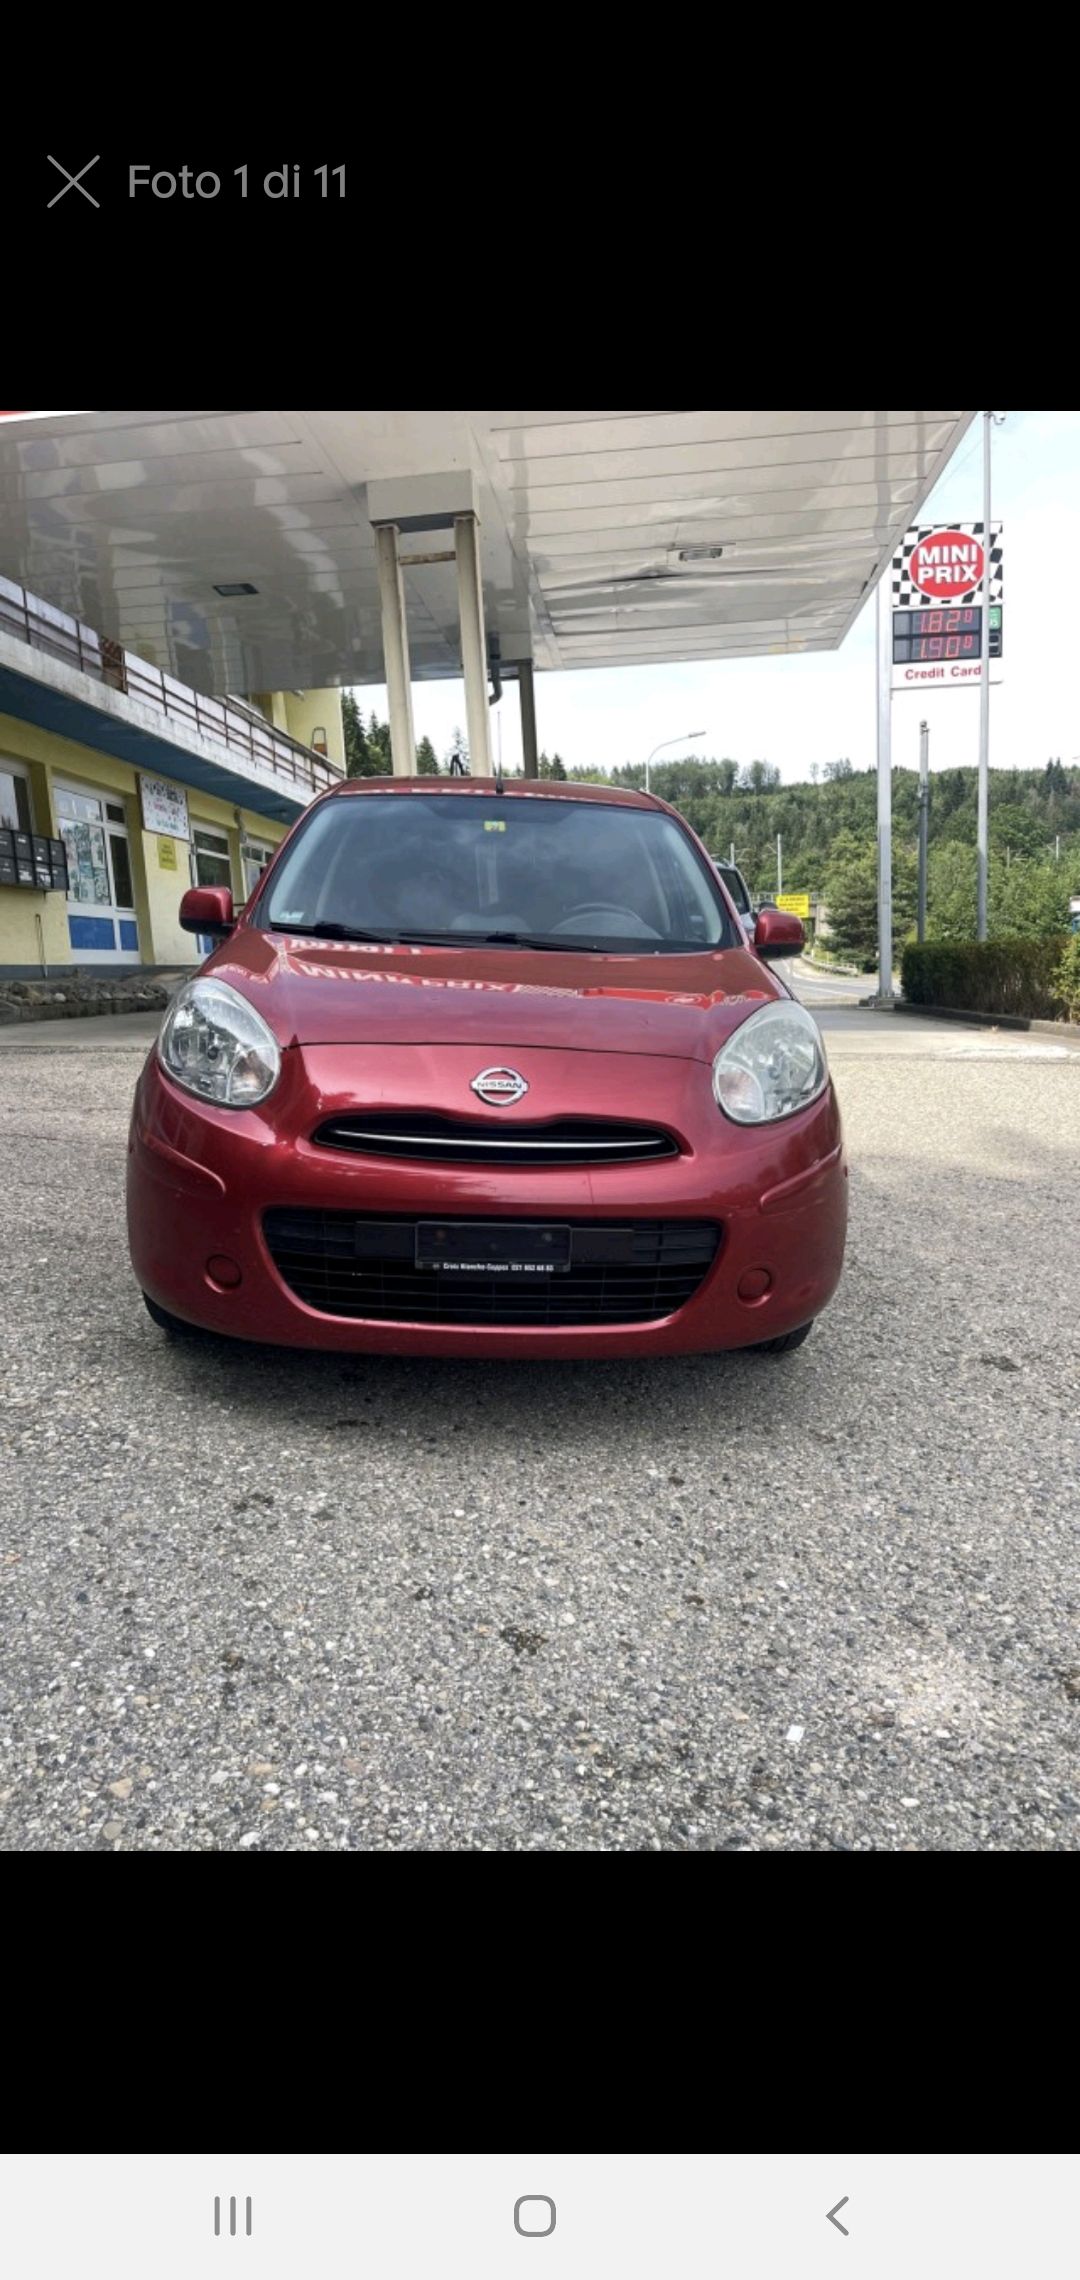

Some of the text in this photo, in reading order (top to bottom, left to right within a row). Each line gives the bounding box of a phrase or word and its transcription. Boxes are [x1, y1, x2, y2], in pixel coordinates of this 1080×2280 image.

[918, 545, 977, 565] MINI
[918, 565, 977, 584] PRIX
[904, 664, 982, 681] Credit Card
